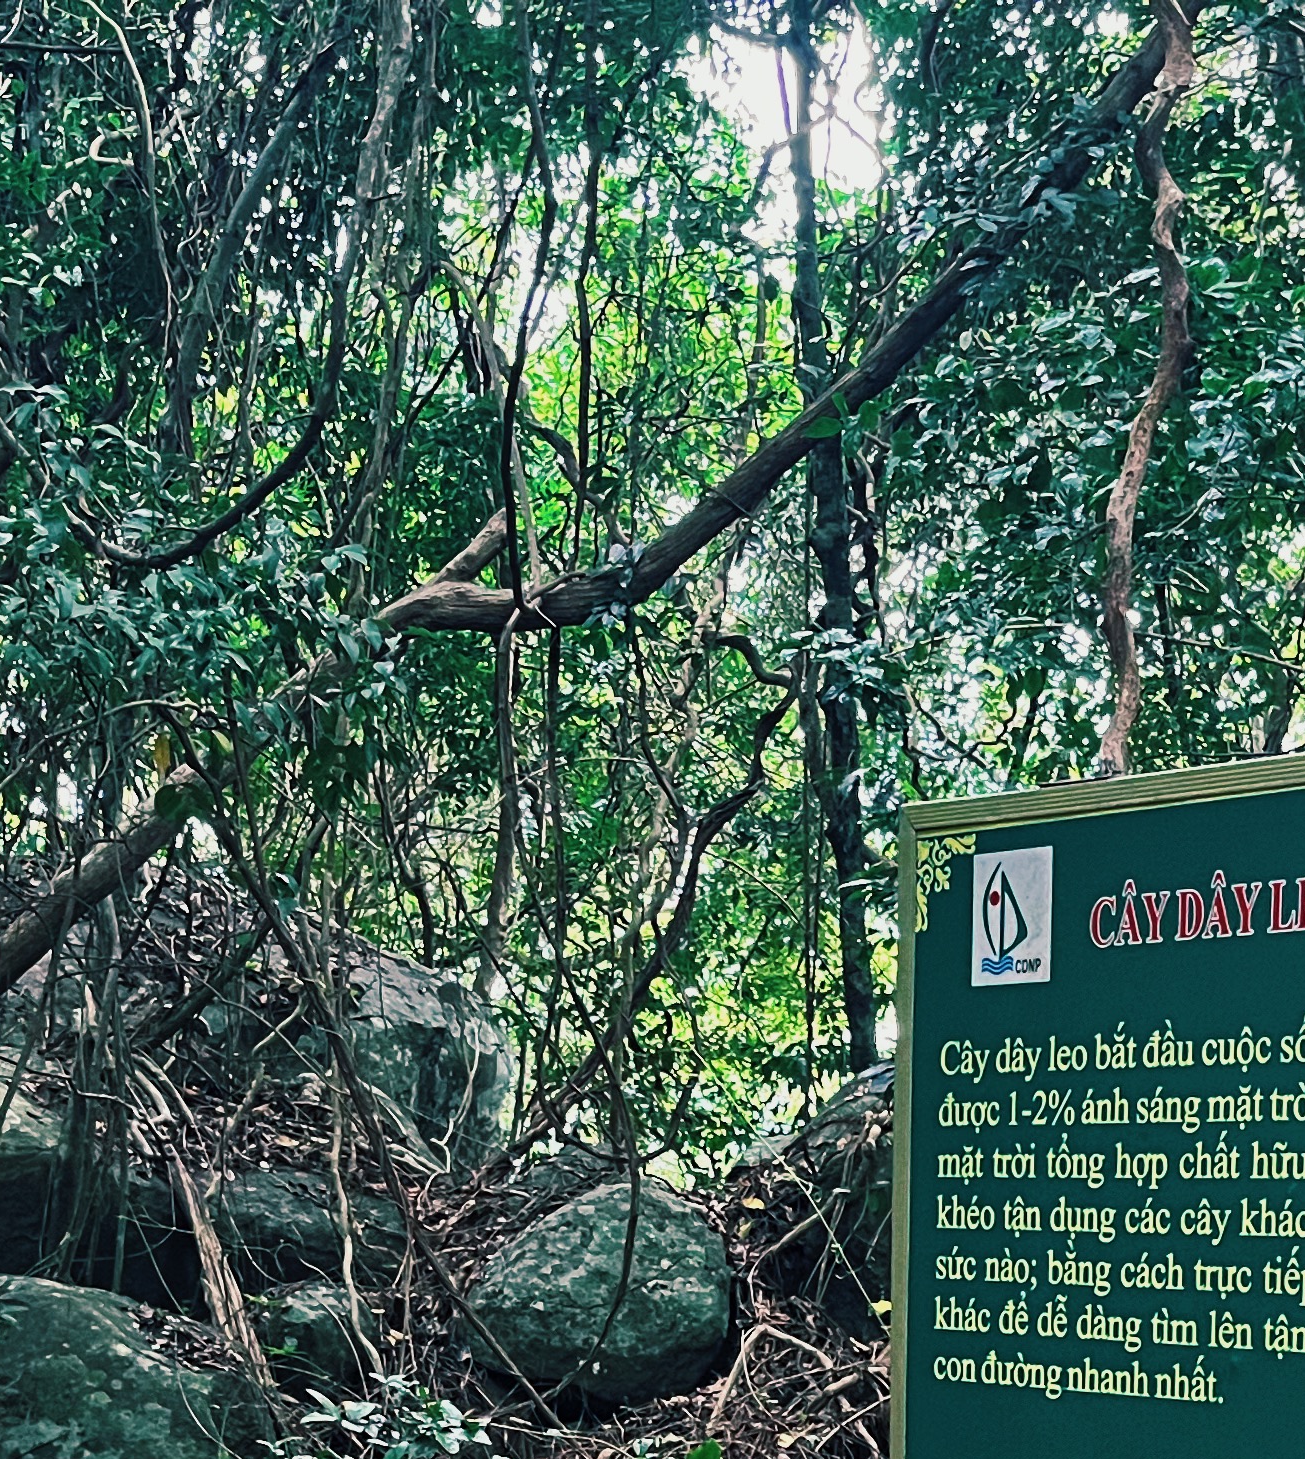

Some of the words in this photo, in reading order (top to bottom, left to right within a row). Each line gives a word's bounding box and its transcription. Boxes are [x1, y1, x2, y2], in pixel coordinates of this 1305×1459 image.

[1090, 879, 1170, 948] CÂY
[1175, 870, 1262, 941] DÂY
[941, 1040, 989, 1083] Cây
[996, 1038, 1041, 1081] dây
[1048, 1036, 1087, 1071] leo
[1095, 1022, 1136, 1069] bắt
[1143, 1020, 1194, 1067] đầu
[1202, 1027, 1271, 1072] cuộc
[939, 1093, 999, 1133] được
[1009, 1089, 1074, 1125] 1-2%
[1081, 1087, 1129, 1124] ánh
[1137, 1087, 1201, 1133] sáng
[1207, 1085, 1263, 1129] mặt
[938, 1146, 983, 1185] mặt
[993, 1143, 1035, 1178] trời
[1047, 1133, 1105, 1188] tổng
[1115, 1143, 1167, 1189] hợp
[1180, 1131, 1239, 1178] chất
[937, 1195, 994, 1229] khéo
[1004, 1196, 1041, 1237] tận
[1050, 1197, 1116, 1242] dụng
[1125, 1198, 1170, 1234] các
[1181, 1199, 1231, 1245] cây
[936, 1246, 976, 1280] sức
[985, 1248, 1036, 1289] nào;
[1047, 1240, 1111, 1296] bằng
[1121, 1252, 1184, 1289] cách
[1194, 1260, 1251, 1299] trực
[934, 1296, 990, 1332] khác
[999, 1291, 1028, 1335] để
[1037, 1295, 1067, 1337] dễ
[1077, 1304, 1141, 1352] dàng
[1151, 1308, 1198, 1345] tìm
[1209, 1311, 1253, 1349] lên
[934, 1357, 976, 1382] con
[981, 1350, 1062, 1399] đường
[1067, 1357, 1149, 1397] nhanh
[1155, 1355, 1223, 1403] nhất.
